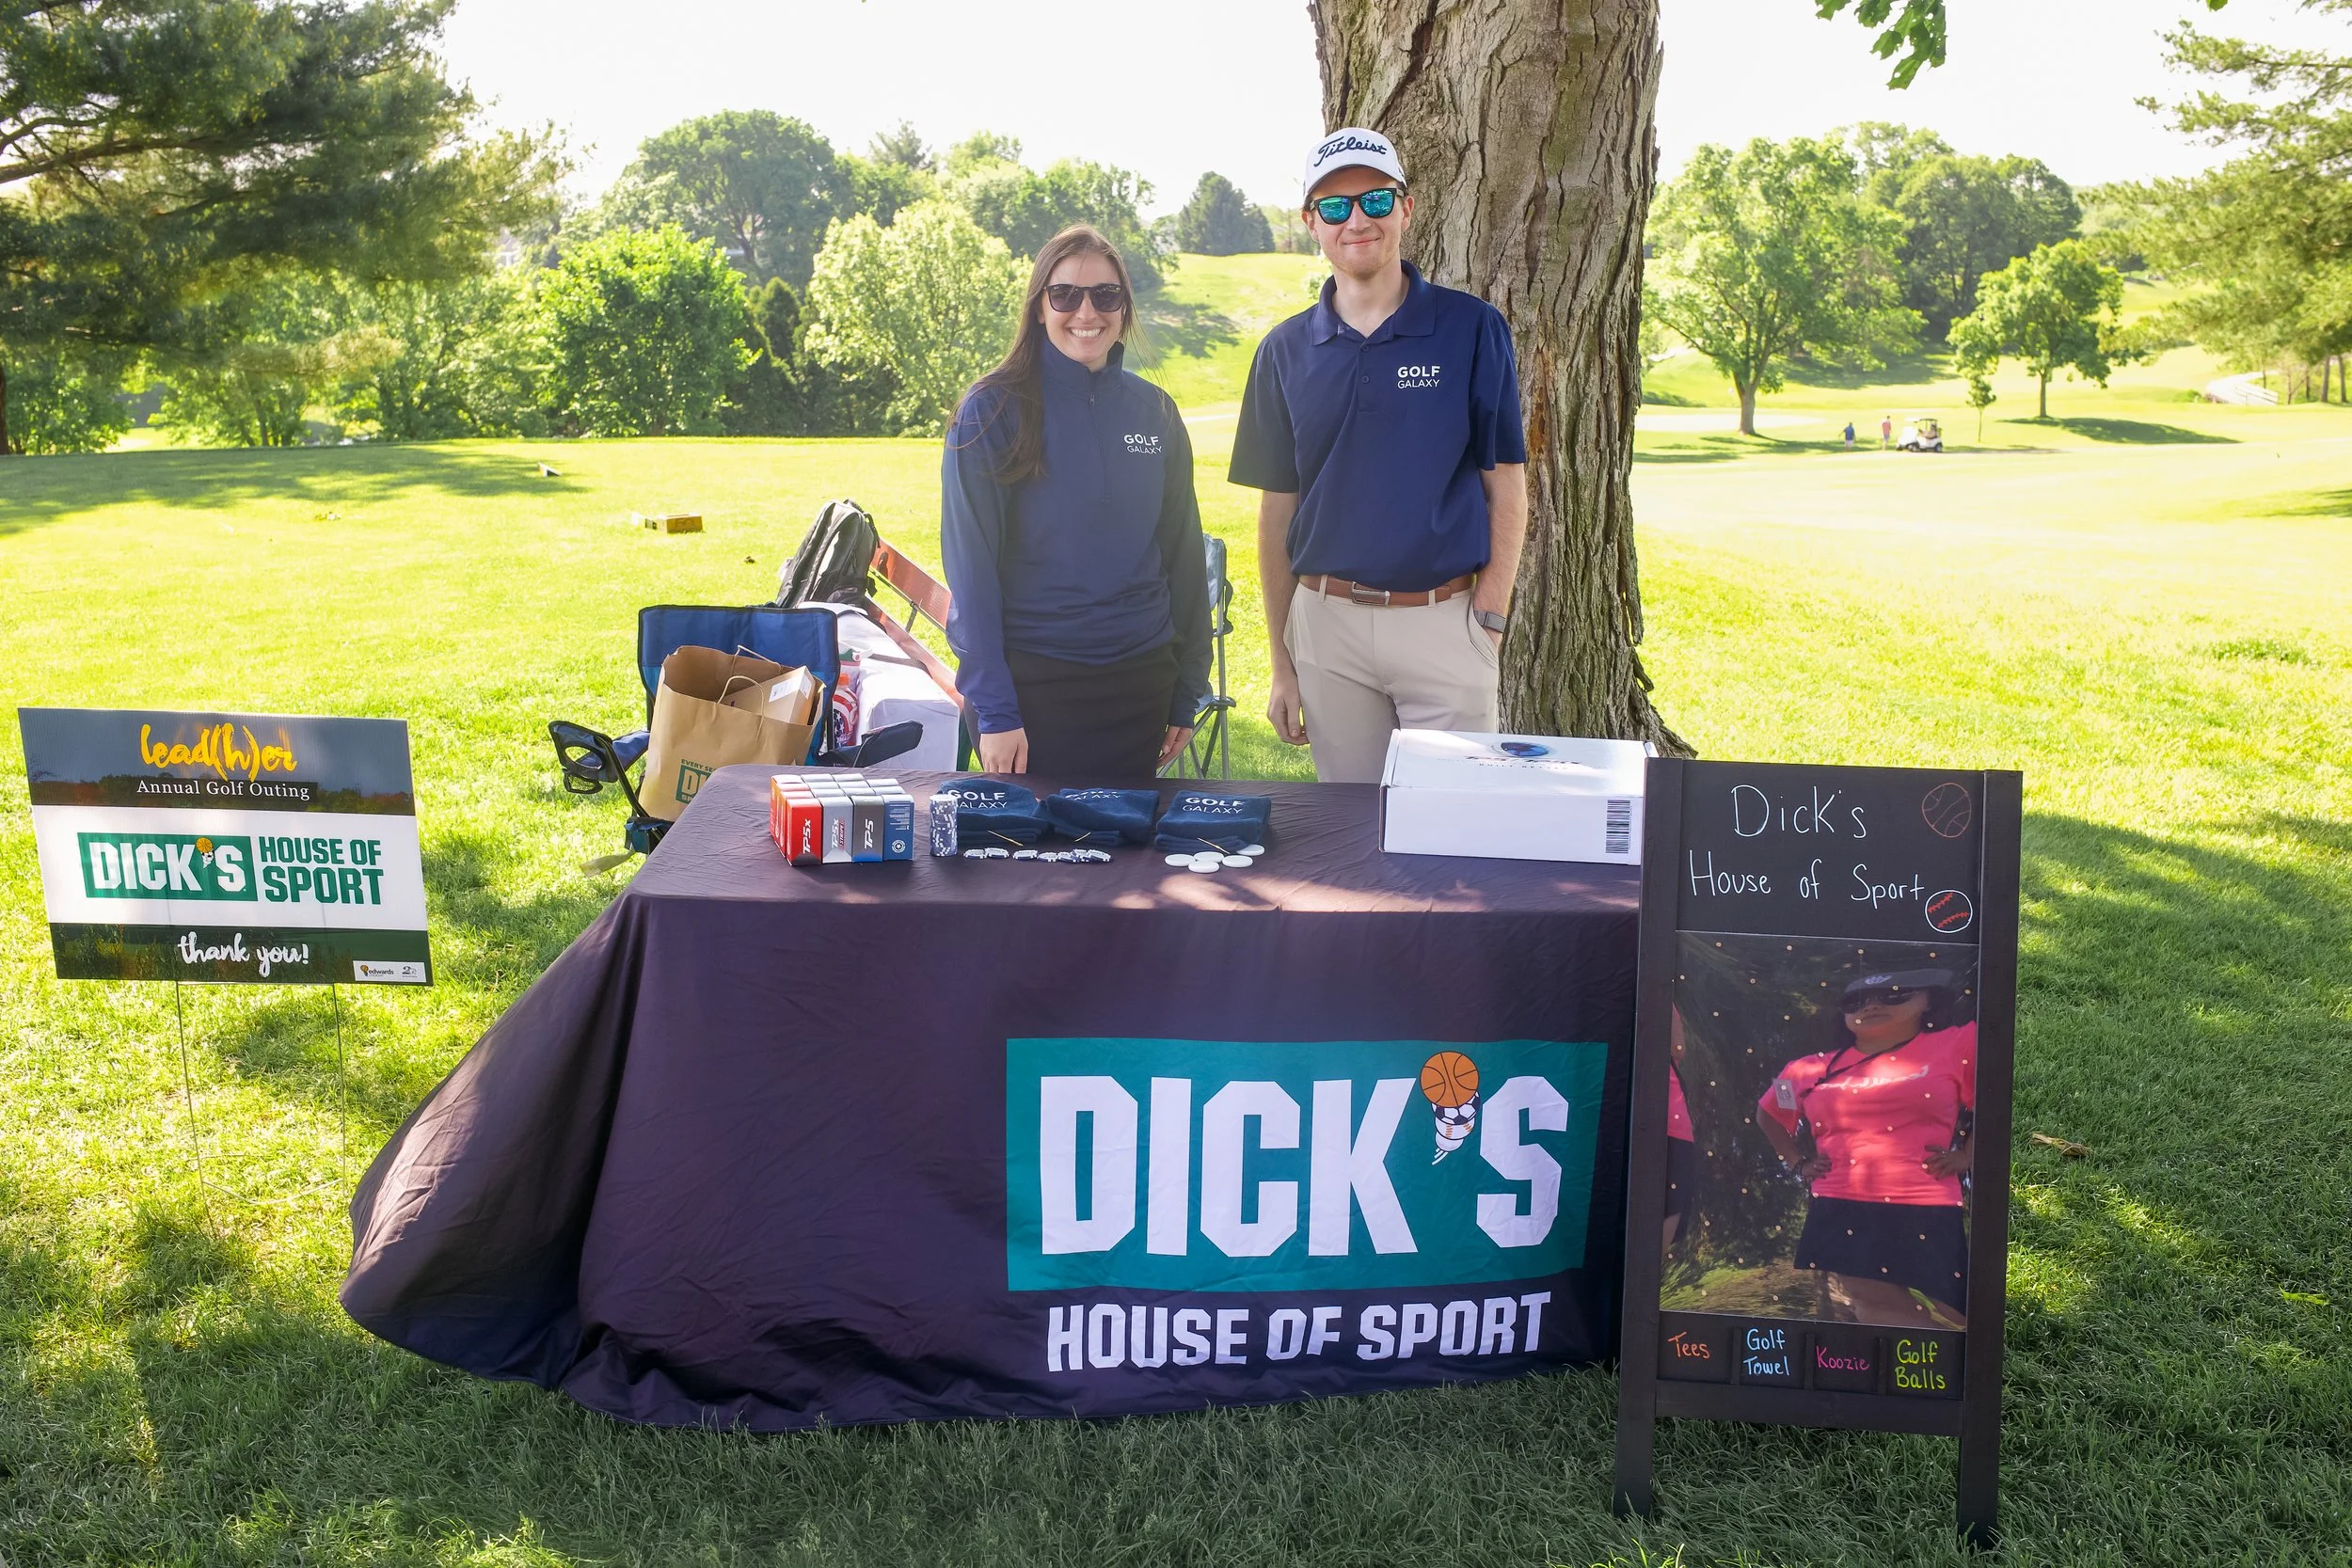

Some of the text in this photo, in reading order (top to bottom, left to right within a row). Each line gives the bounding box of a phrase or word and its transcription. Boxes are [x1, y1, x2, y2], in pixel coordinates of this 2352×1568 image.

[1313, 135, 1388, 167] Titleist
[1397, 365, 1440, 378] GOLF
[1397, 378, 1440, 389] GALAXY
[1123, 433, 1159, 446] GOLF
[1126, 445, 1162, 454] GALAXY
[681, 758, 704, 769] EVERY
[136, 780, 310, 800] Annual Golf Outing
[947, 789, 1006, 800] GOLF
[1184, 797, 1246, 807] GOLF
[1182, 805, 1243, 814] GALAXY
[1730, 784, 1867, 839] Dick's
[831, 818, 839, 848] TP5x
[864, 818, 874, 849] TP5
[258, 835, 382, 866] HOUSE OF
[88, 837, 248, 893] DICK'S
[262, 865, 385, 906] SPORT
[1689, 848, 1926, 910] House of Sport
[177, 930, 310, 978] thank you!
[1040, 1050, 1570, 1258] DICK'S
[1047, 1291, 1552, 1372] HOUSE OF SPORT
[1746, 1327, 1787, 1352] Golf
[1667, 1331, 1711, 1360] Tees
[1815, 1345, 1871, 1371] Koozie
[1896, 1338, 1939, 1365] Golf
[1742, 1355, 1791, 1377] Towel
[1894, 1365, 1947, 1390] Balls
